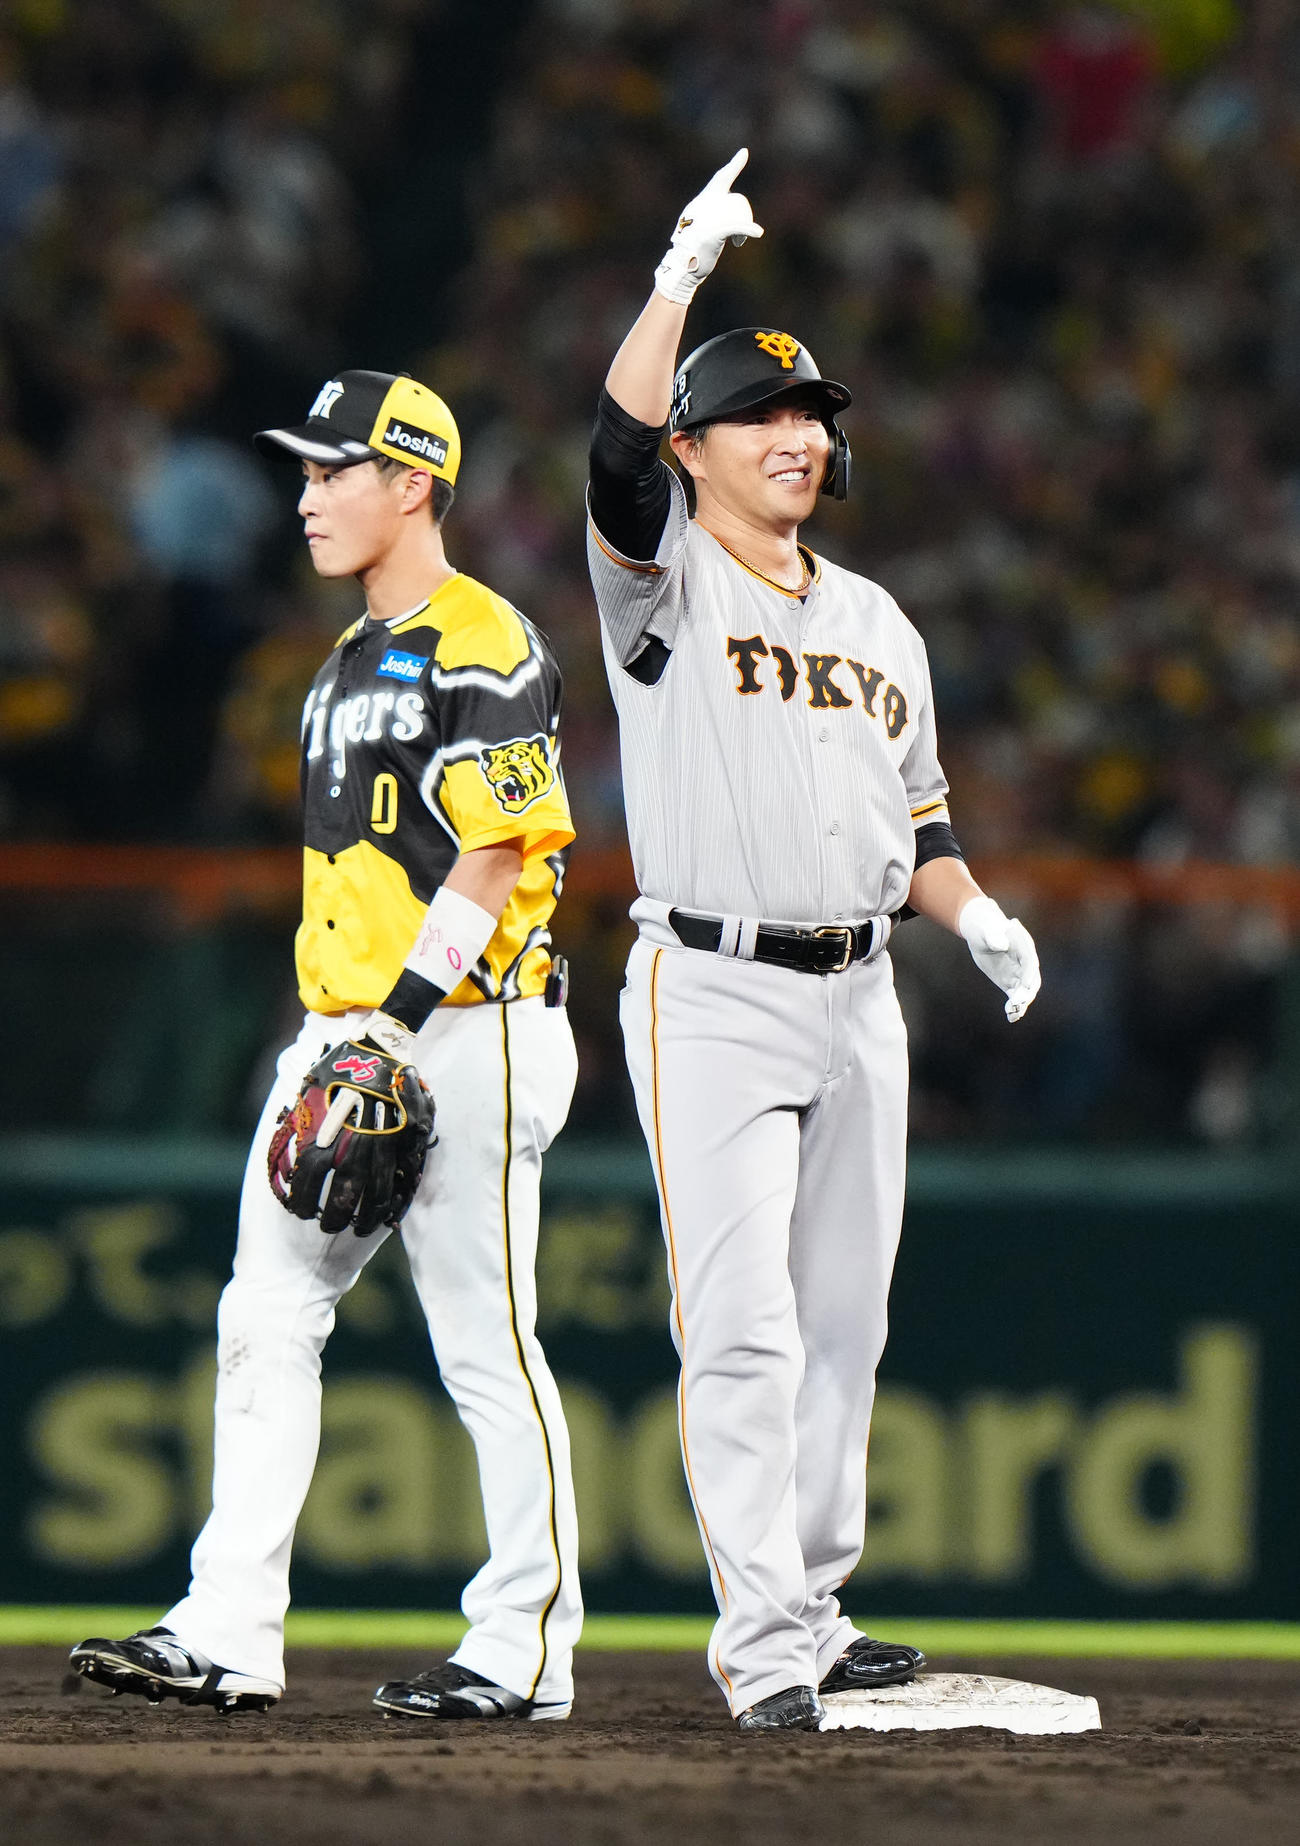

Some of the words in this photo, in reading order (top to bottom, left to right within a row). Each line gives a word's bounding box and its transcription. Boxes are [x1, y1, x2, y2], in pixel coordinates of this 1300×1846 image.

[384, 424, 446, 464] Joshin
[380, 655, 423, 678] Joshin
[726, 634, 909, 740] TOKYO
[370, 772, 398, 835] 0
[28, 1322, 1258, 1592] sanard
